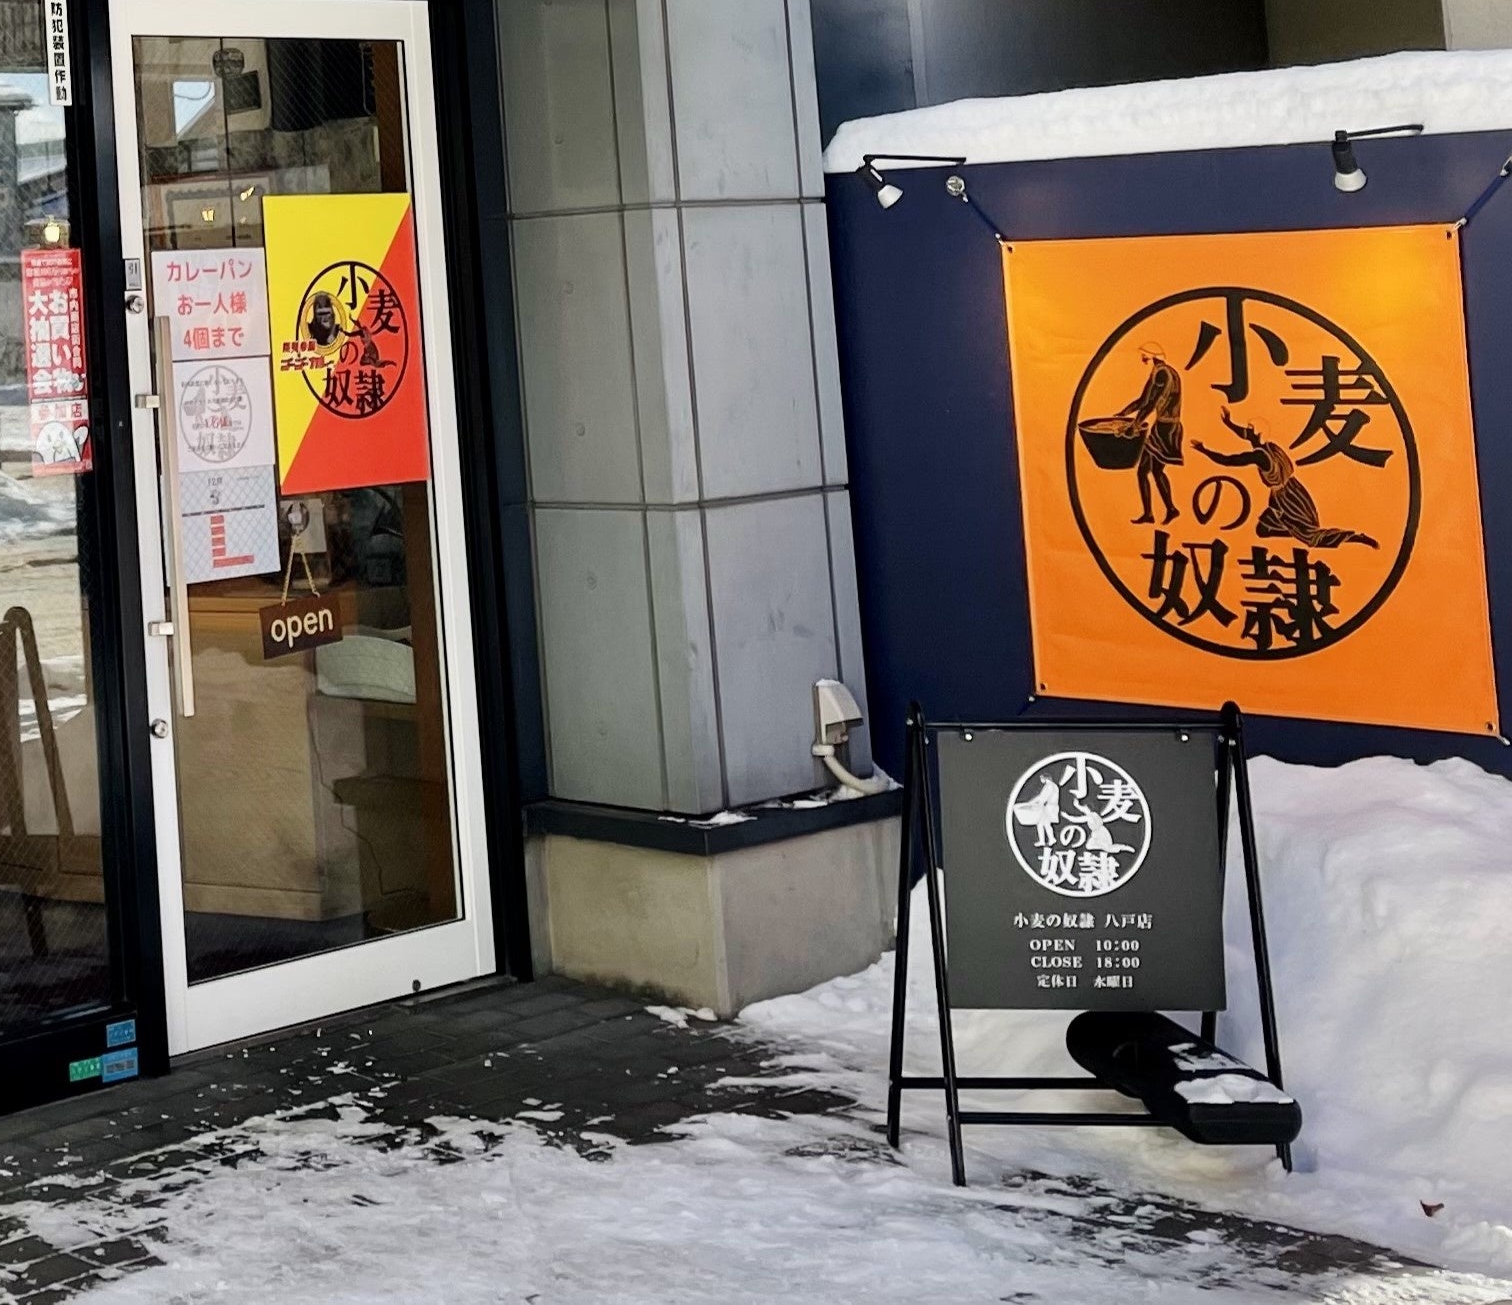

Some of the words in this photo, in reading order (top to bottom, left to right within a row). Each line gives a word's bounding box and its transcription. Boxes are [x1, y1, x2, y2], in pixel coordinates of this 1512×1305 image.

[51, 2, 67, 101] 防犯装置作動
[167, 258, 252, 282] カレーパン
[177, 291, 248, 316] お一人様
[183, 326, 245, 350] 4個まで
[271, 608, 334, 648] open
[1013, 912, 1095, 929] 小麦の奴隷
[1104, 912, 1153, 929] 八戸店
[1029, 939, 1076, 951] OPEN
[1096, 939, 1140, 952] 10:00
[1031, 956, 1083, 969] CLOSE
[1097, 957, 1140, 969] 18:00
[1037, 974, 1077, 988] 定休日
[1094, 974, 1134, 988] 水曜日
